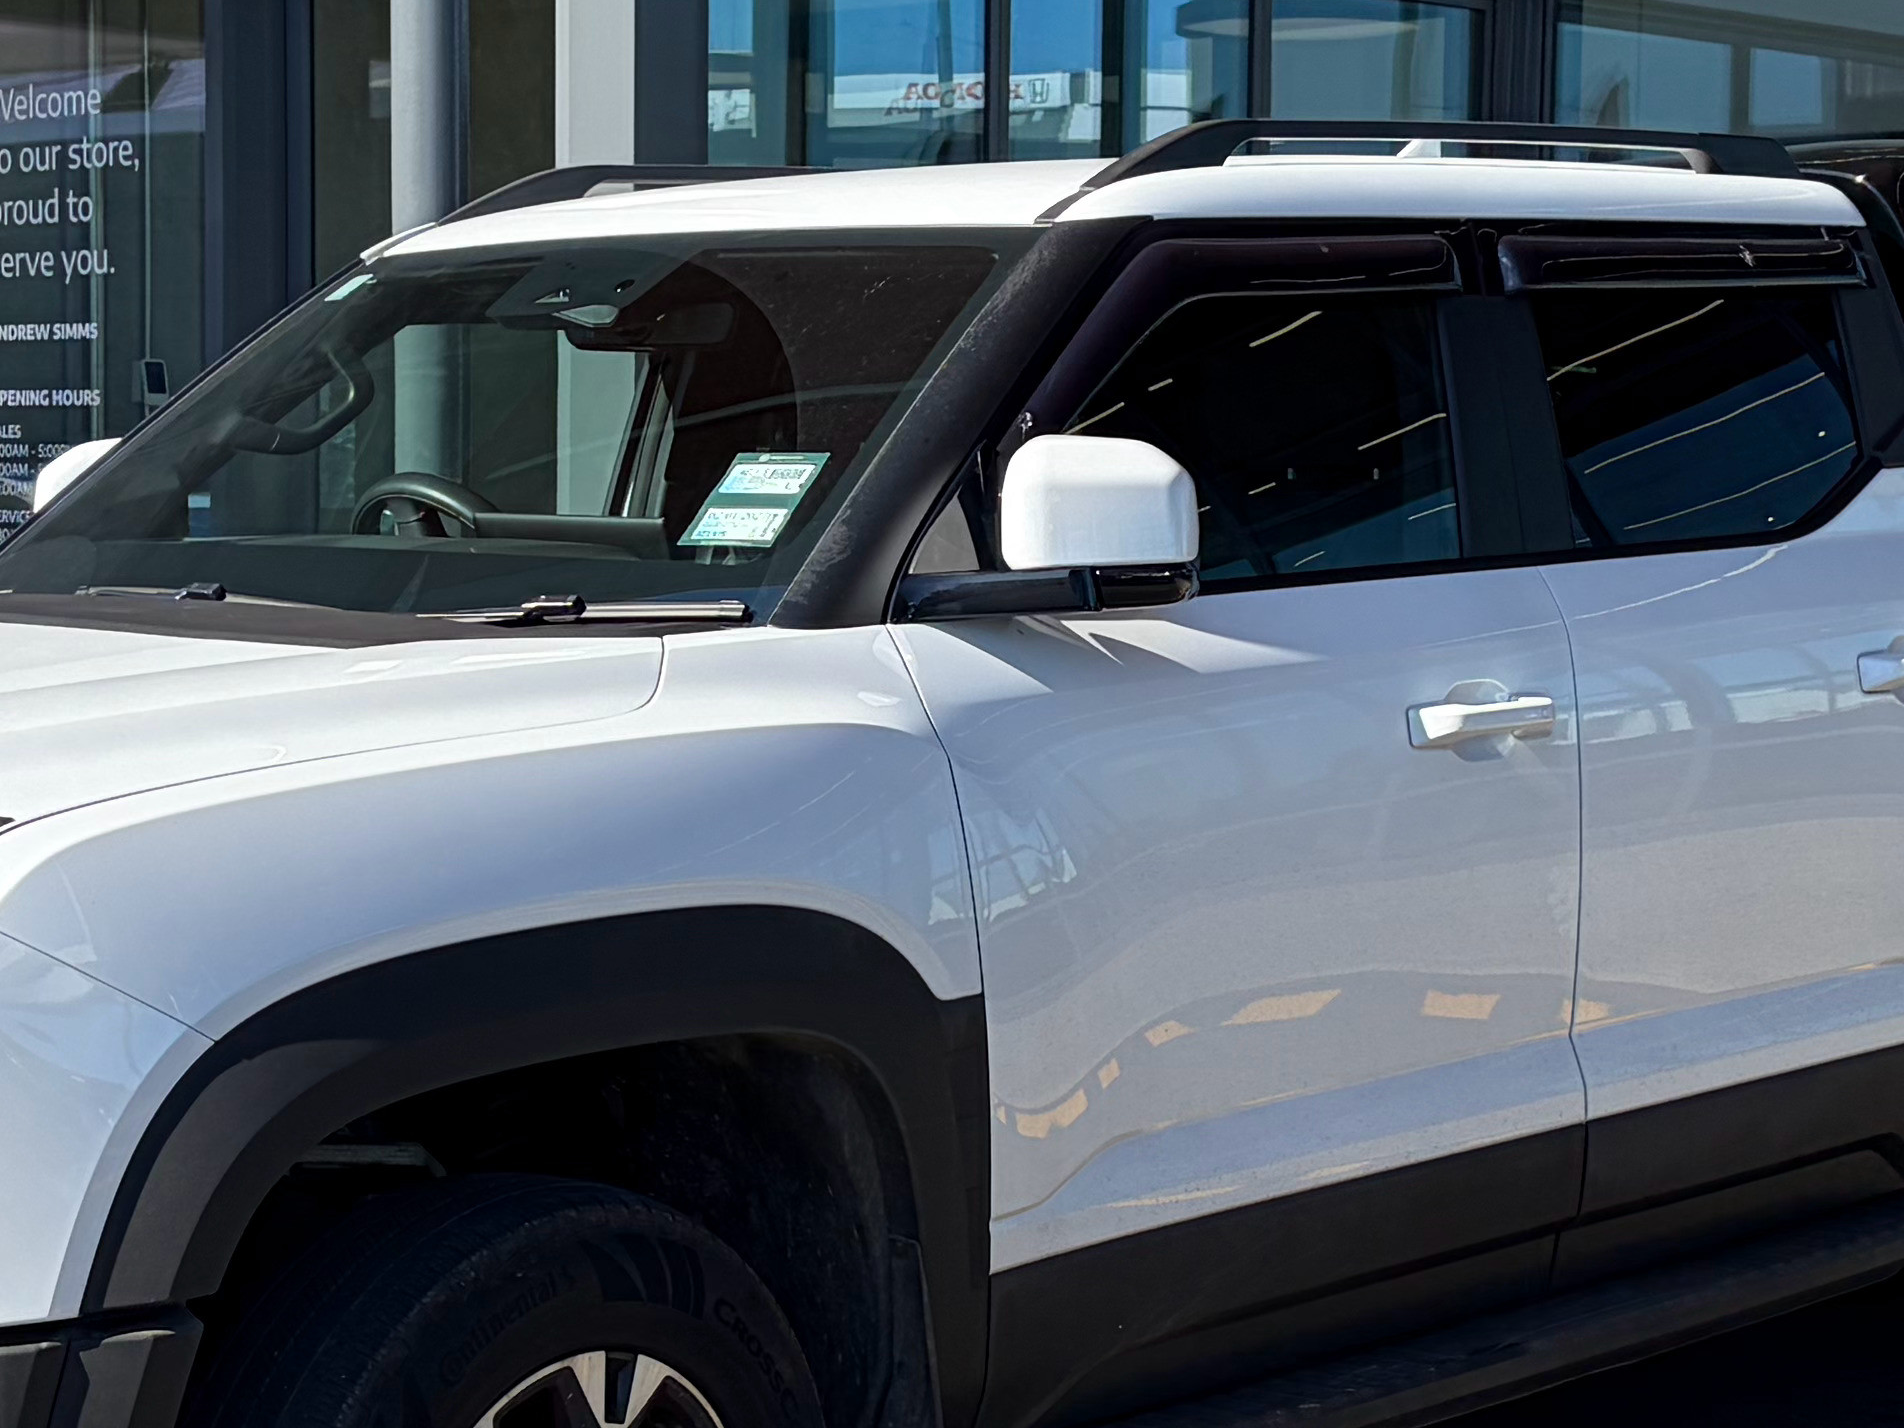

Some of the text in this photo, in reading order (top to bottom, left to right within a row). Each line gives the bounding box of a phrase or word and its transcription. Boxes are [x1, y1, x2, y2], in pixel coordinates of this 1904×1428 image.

[19, 144, 62, 173] our
[67, 135, 140, 172] store,
[66, 189, 94, 223] to
[61, 248, 116, 285] you.
[52, 322, 98, 340] SIMMS
[51, 389, 101, 407] HOURS
